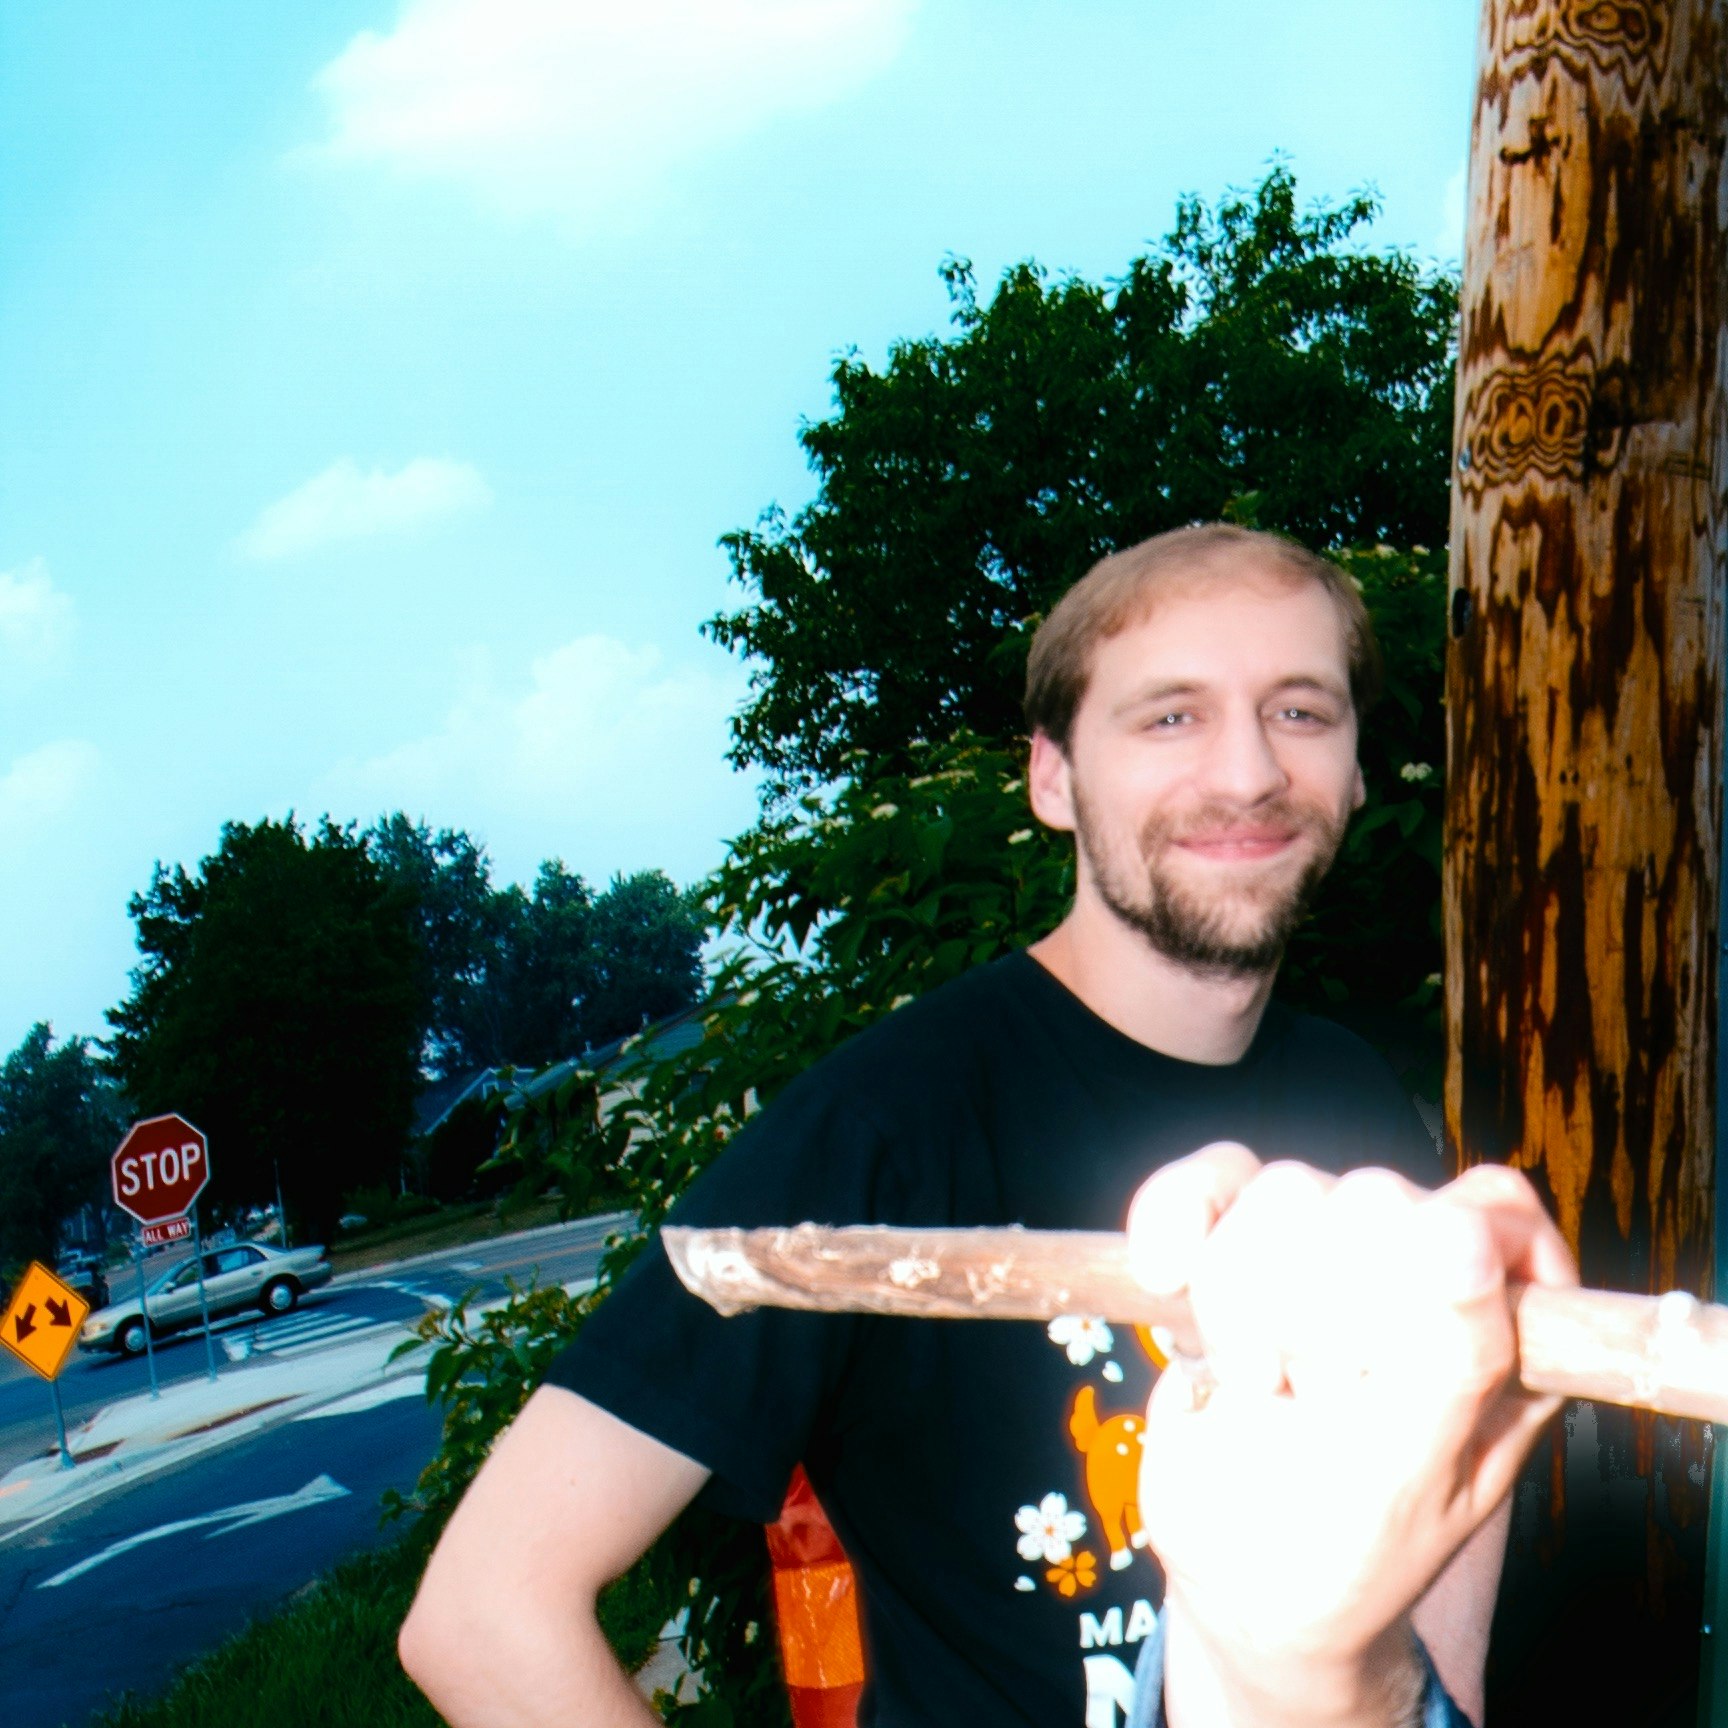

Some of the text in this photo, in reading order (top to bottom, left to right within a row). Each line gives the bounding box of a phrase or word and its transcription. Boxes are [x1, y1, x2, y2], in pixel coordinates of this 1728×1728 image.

[121, 1142, 201, 1196] STOP
[145, 1221, 189, 1243] ALL WAY
